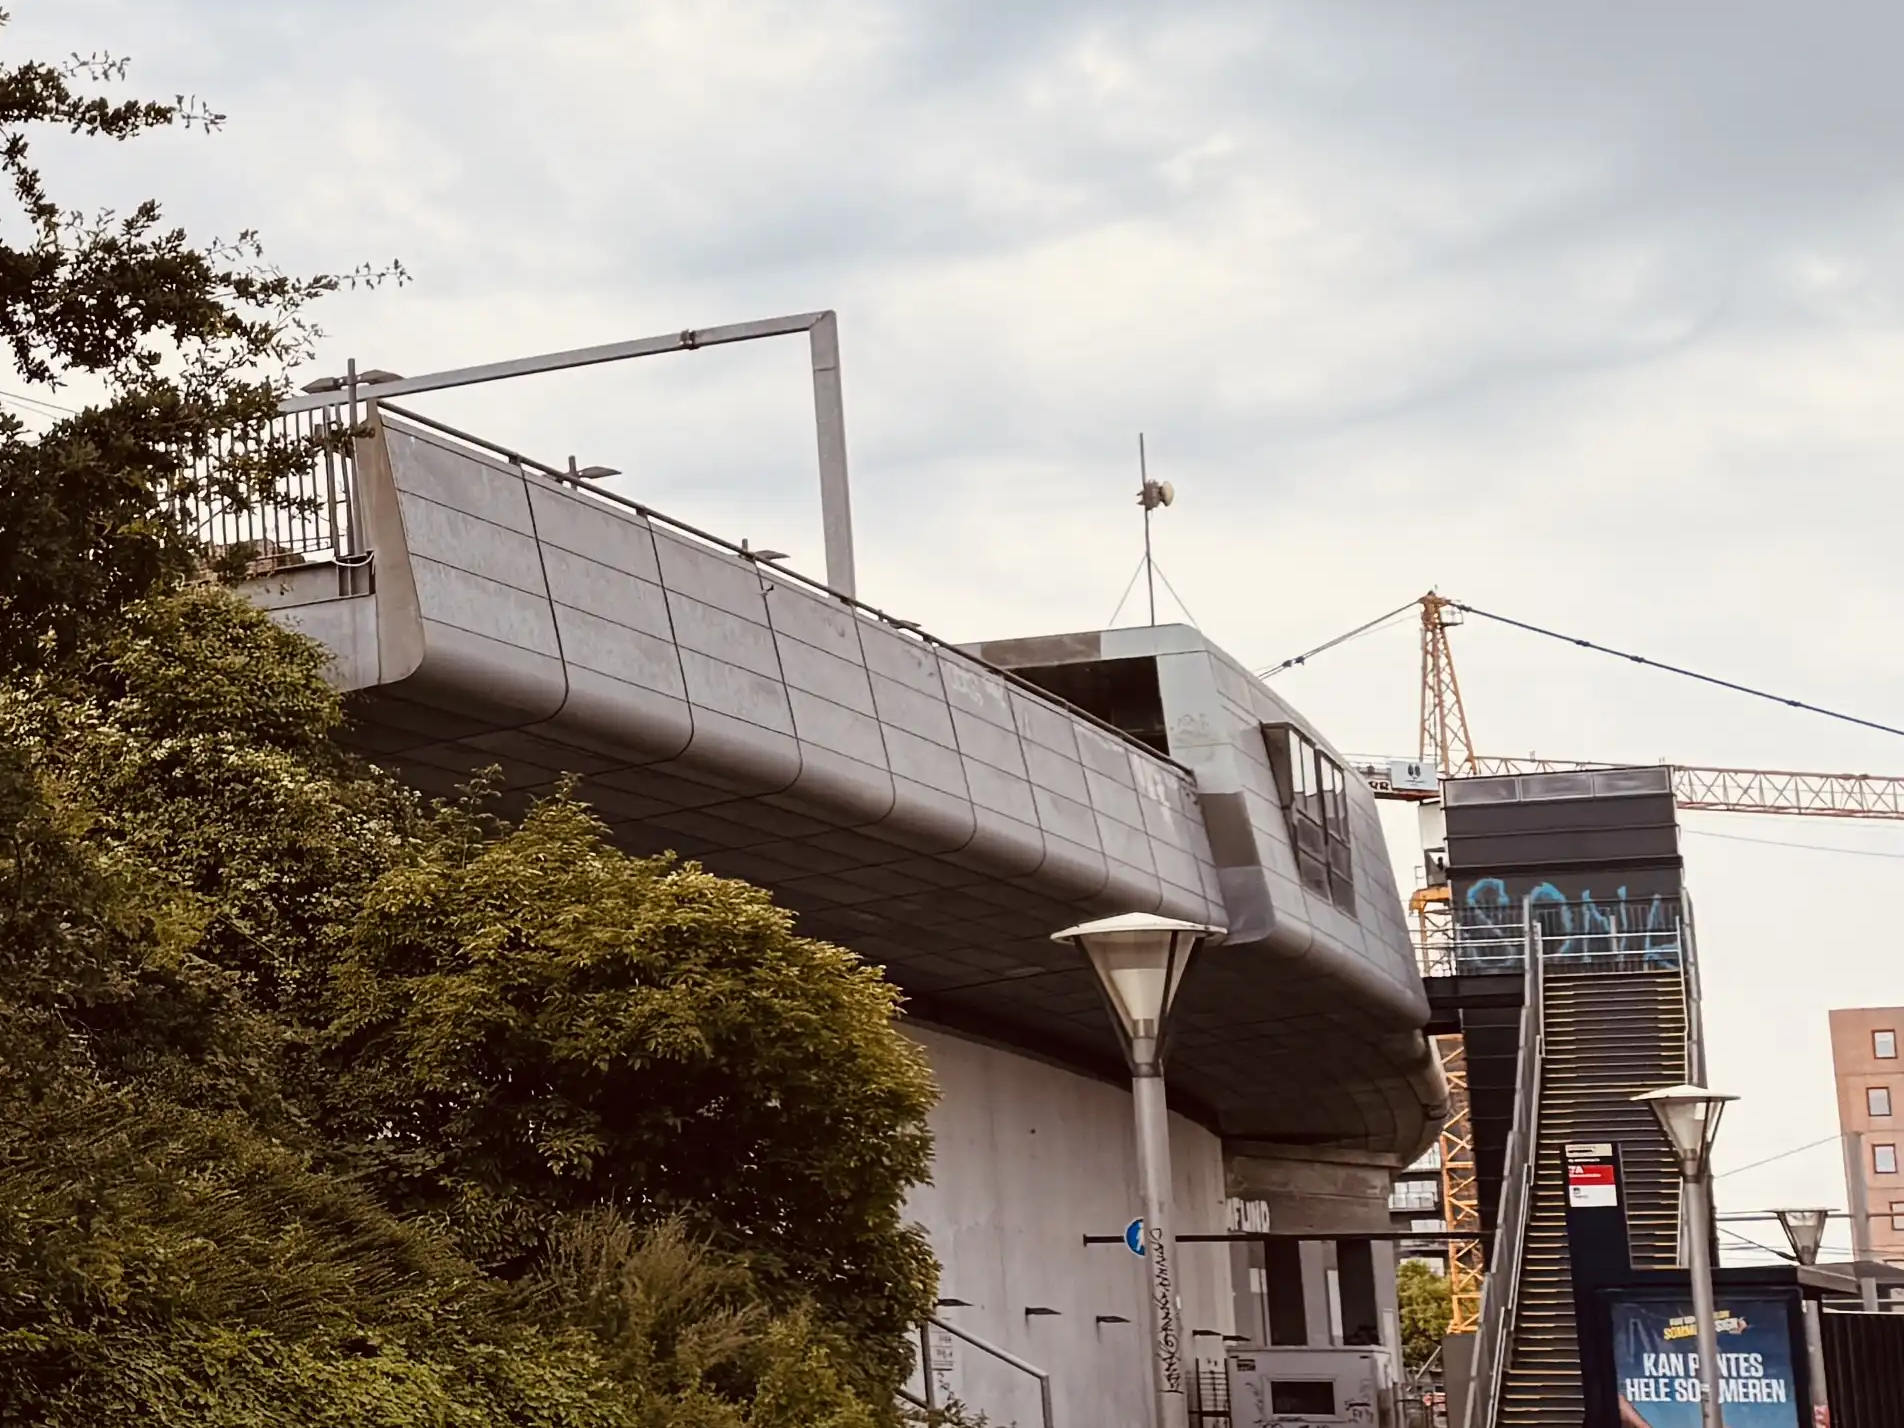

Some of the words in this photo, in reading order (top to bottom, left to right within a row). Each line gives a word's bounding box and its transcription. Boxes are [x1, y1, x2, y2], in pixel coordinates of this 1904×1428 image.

[1643, 1352, 1685, 1377] KAN
[1688, 1352, 1764, 1378] PNTES
[1626, 1378, 1672, 1403] HELE
[1675, 1378, 1786, 1404] SOMEREN
